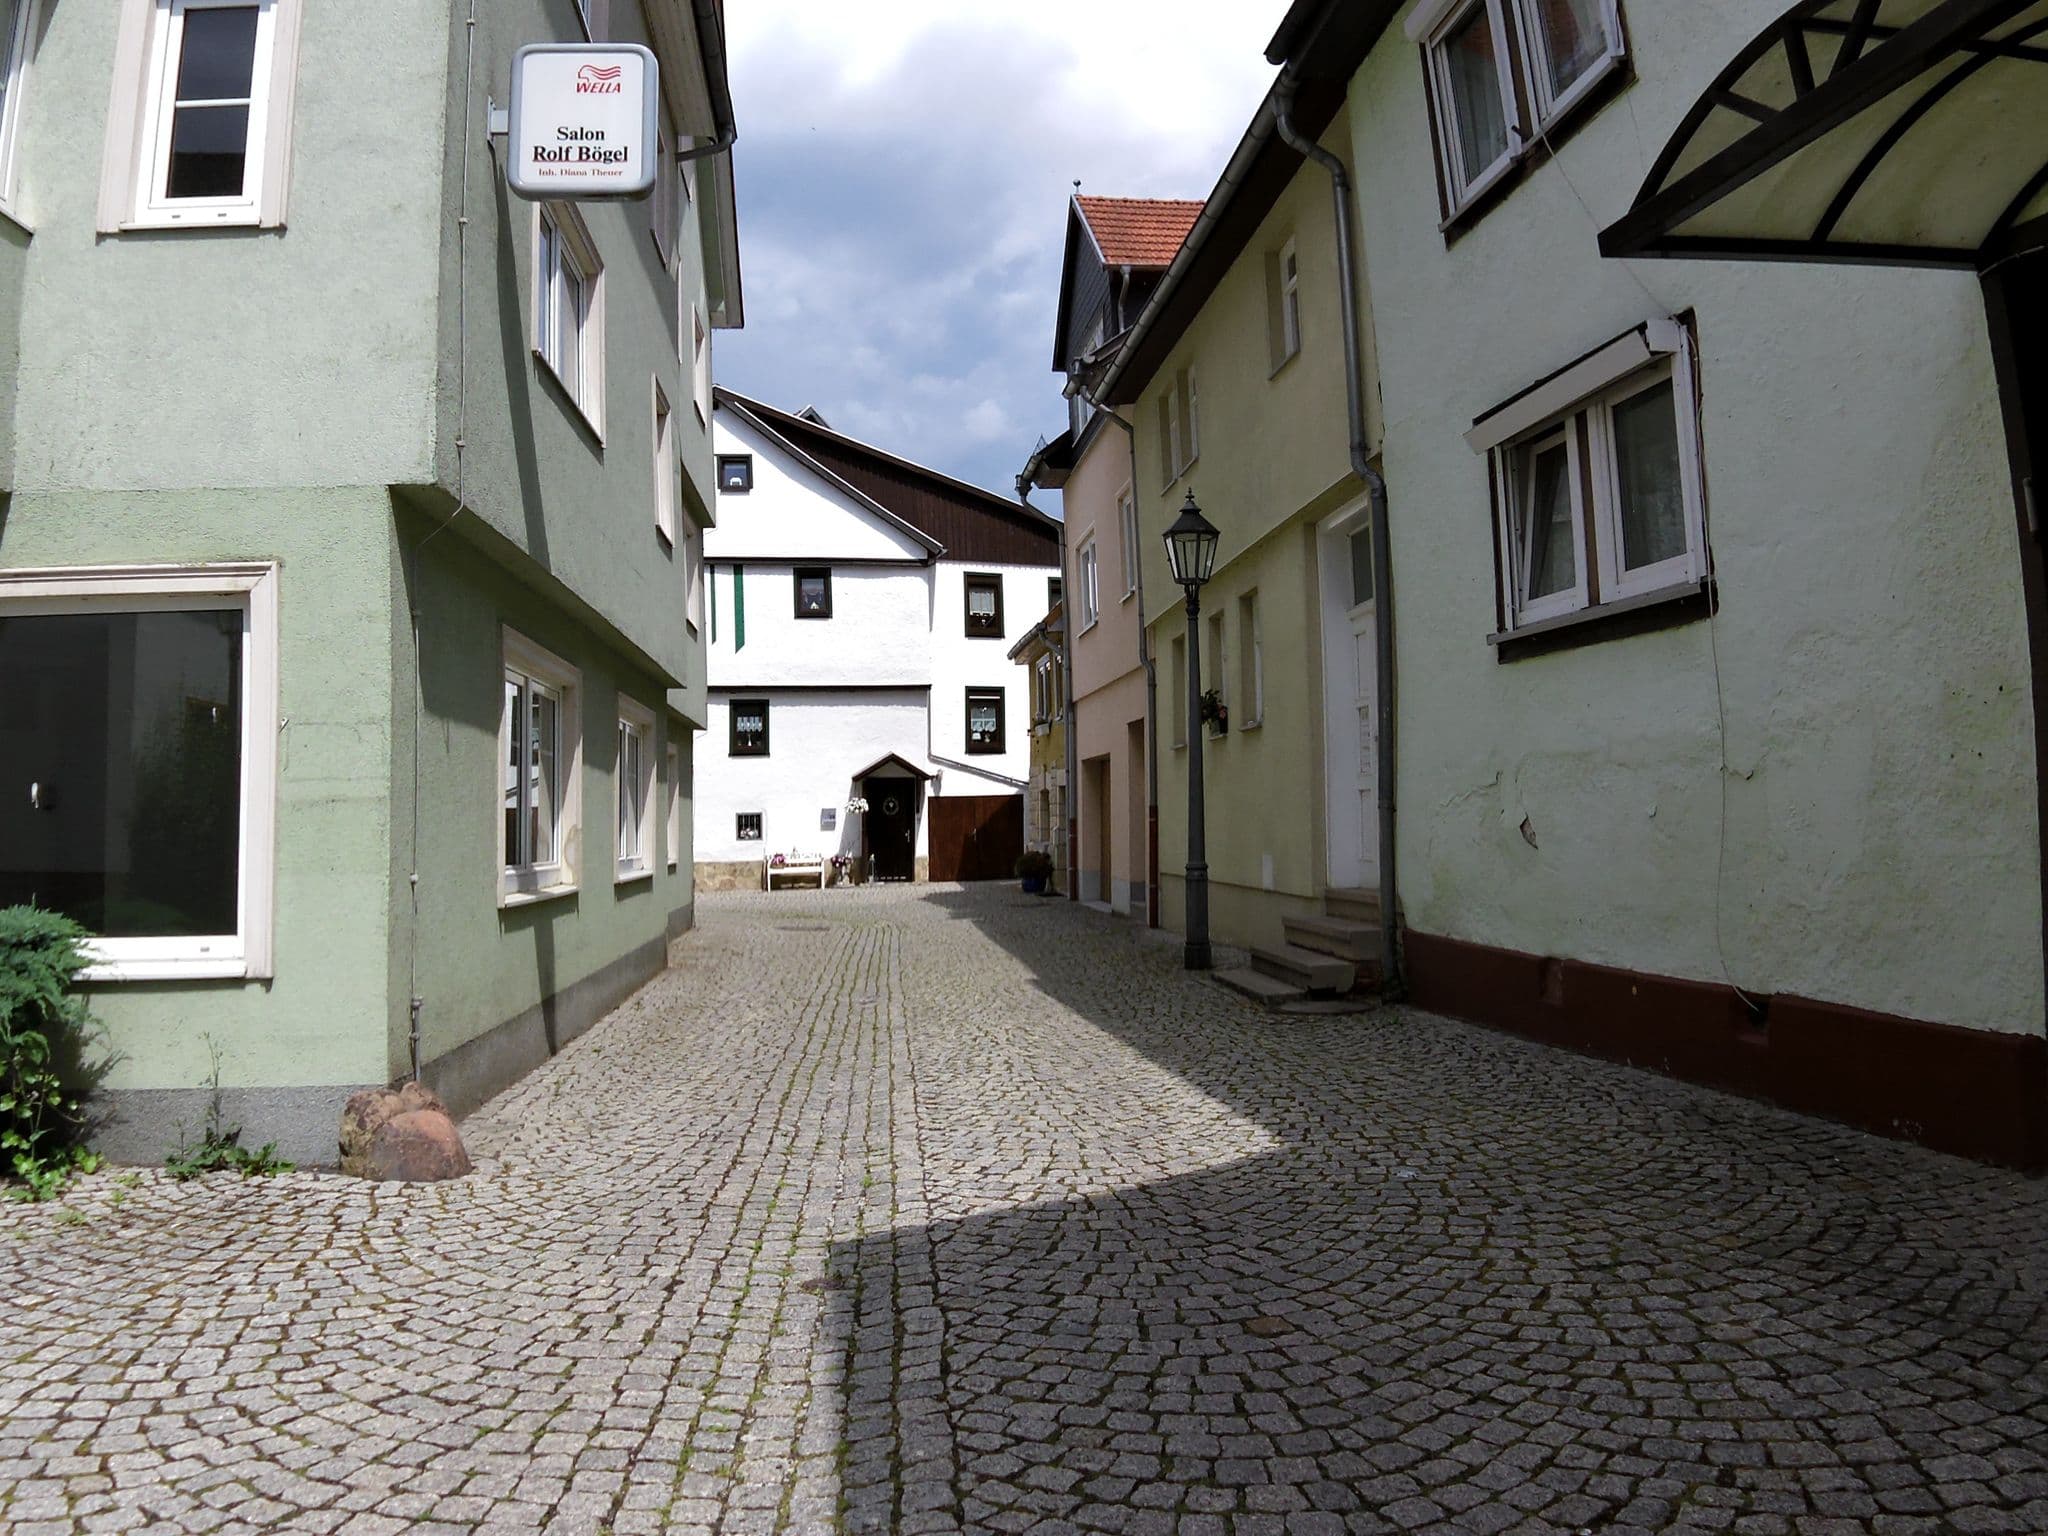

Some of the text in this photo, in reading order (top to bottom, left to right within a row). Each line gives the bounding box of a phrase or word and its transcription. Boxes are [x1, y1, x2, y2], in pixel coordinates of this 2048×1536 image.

[576, 82, 621, 94] WELLA
[556, 126, 605, 141] Salon
[532, 146, 629, 164] Rolf Bögel
[538, 168, 557, 177] Inh.
[560, 168, 587, 177] Diana
